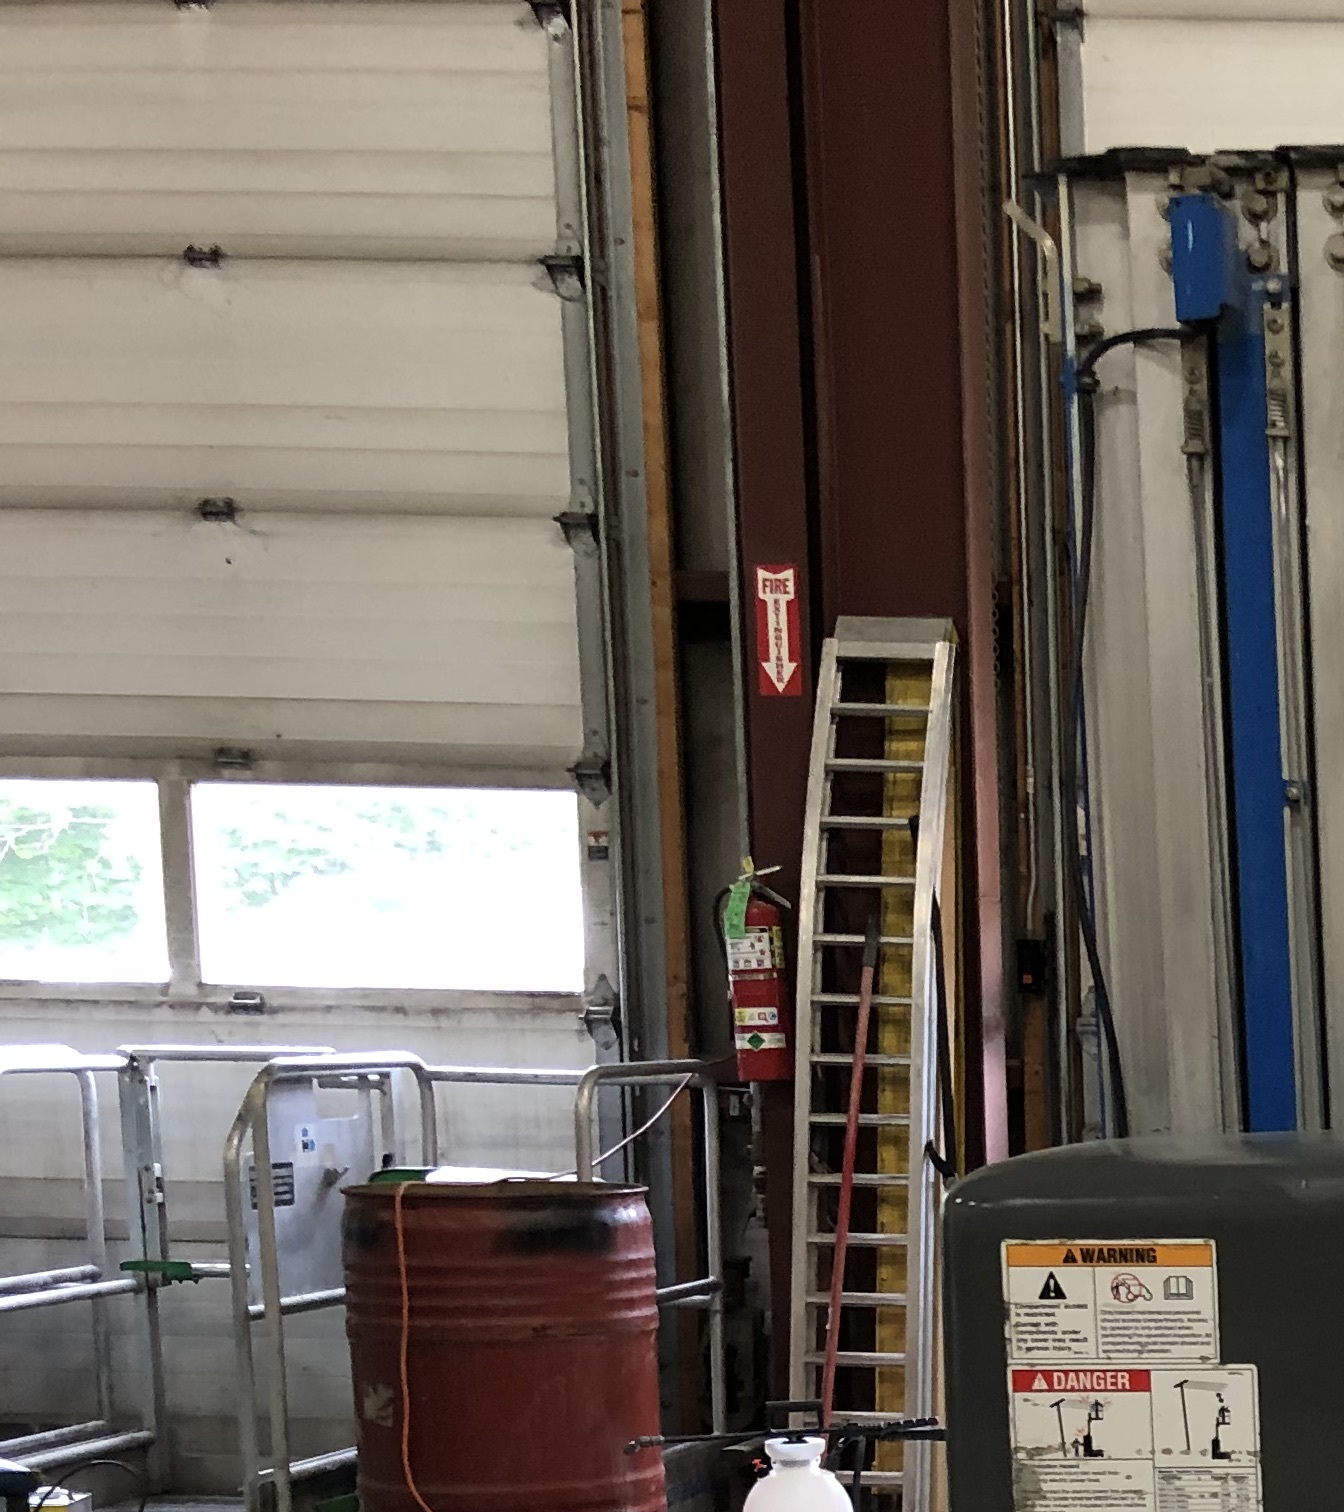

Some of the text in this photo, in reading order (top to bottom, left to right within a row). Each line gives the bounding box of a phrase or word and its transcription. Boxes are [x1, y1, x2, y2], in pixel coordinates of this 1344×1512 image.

[762, 578, 790, 595] FIRE
[1080, 1248, 1157, 1263] WARNING
[1053, 1372, 1130, 1390] DANGER
